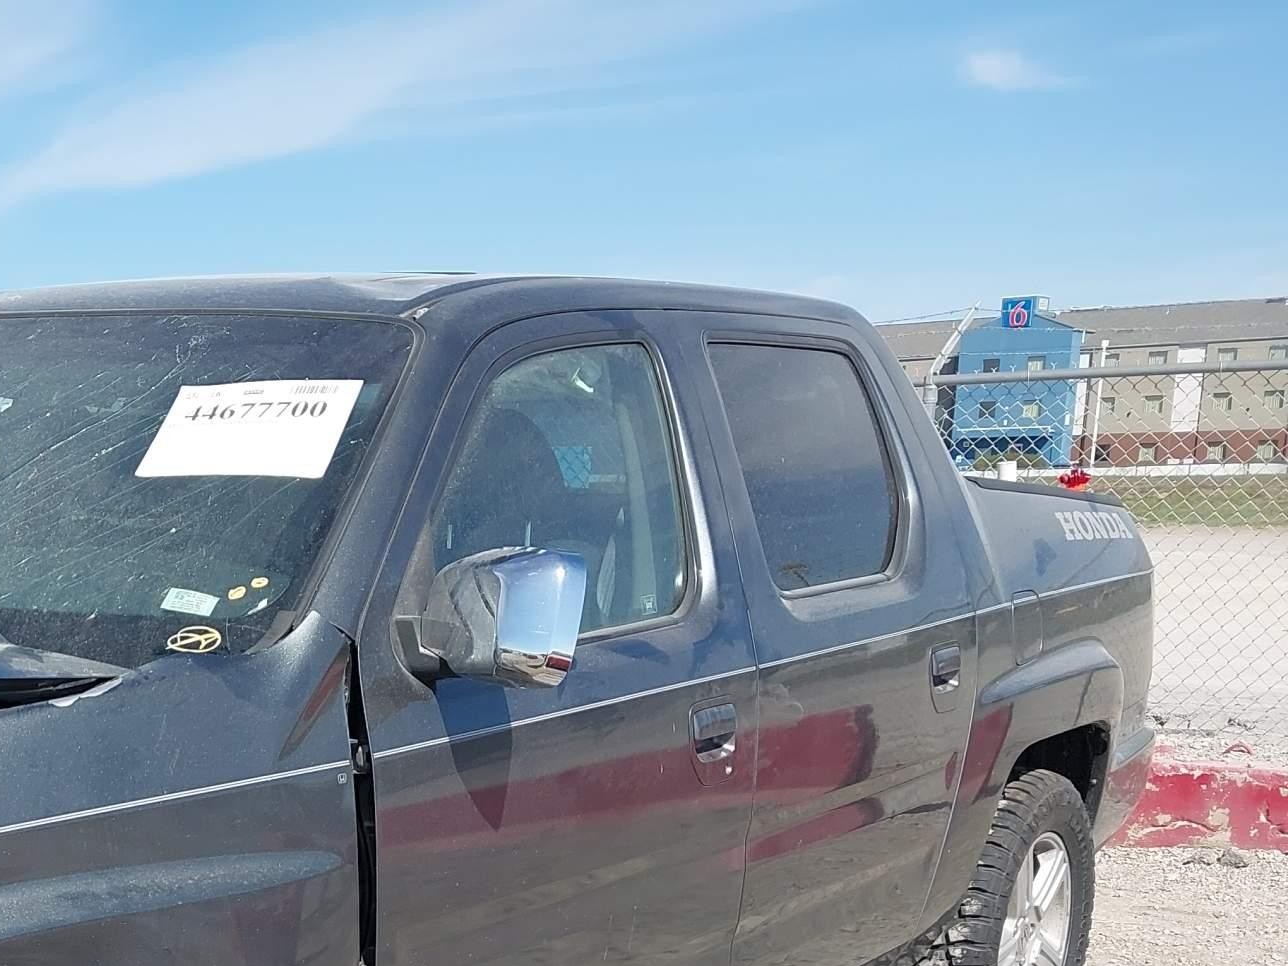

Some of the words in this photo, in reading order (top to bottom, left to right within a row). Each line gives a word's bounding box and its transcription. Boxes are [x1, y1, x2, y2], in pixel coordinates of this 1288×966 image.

[1009, 300, 1028, 328] 6
[184, 400, 328, 421] 44677700
[1054, 510, 1135, 541] HONDA
